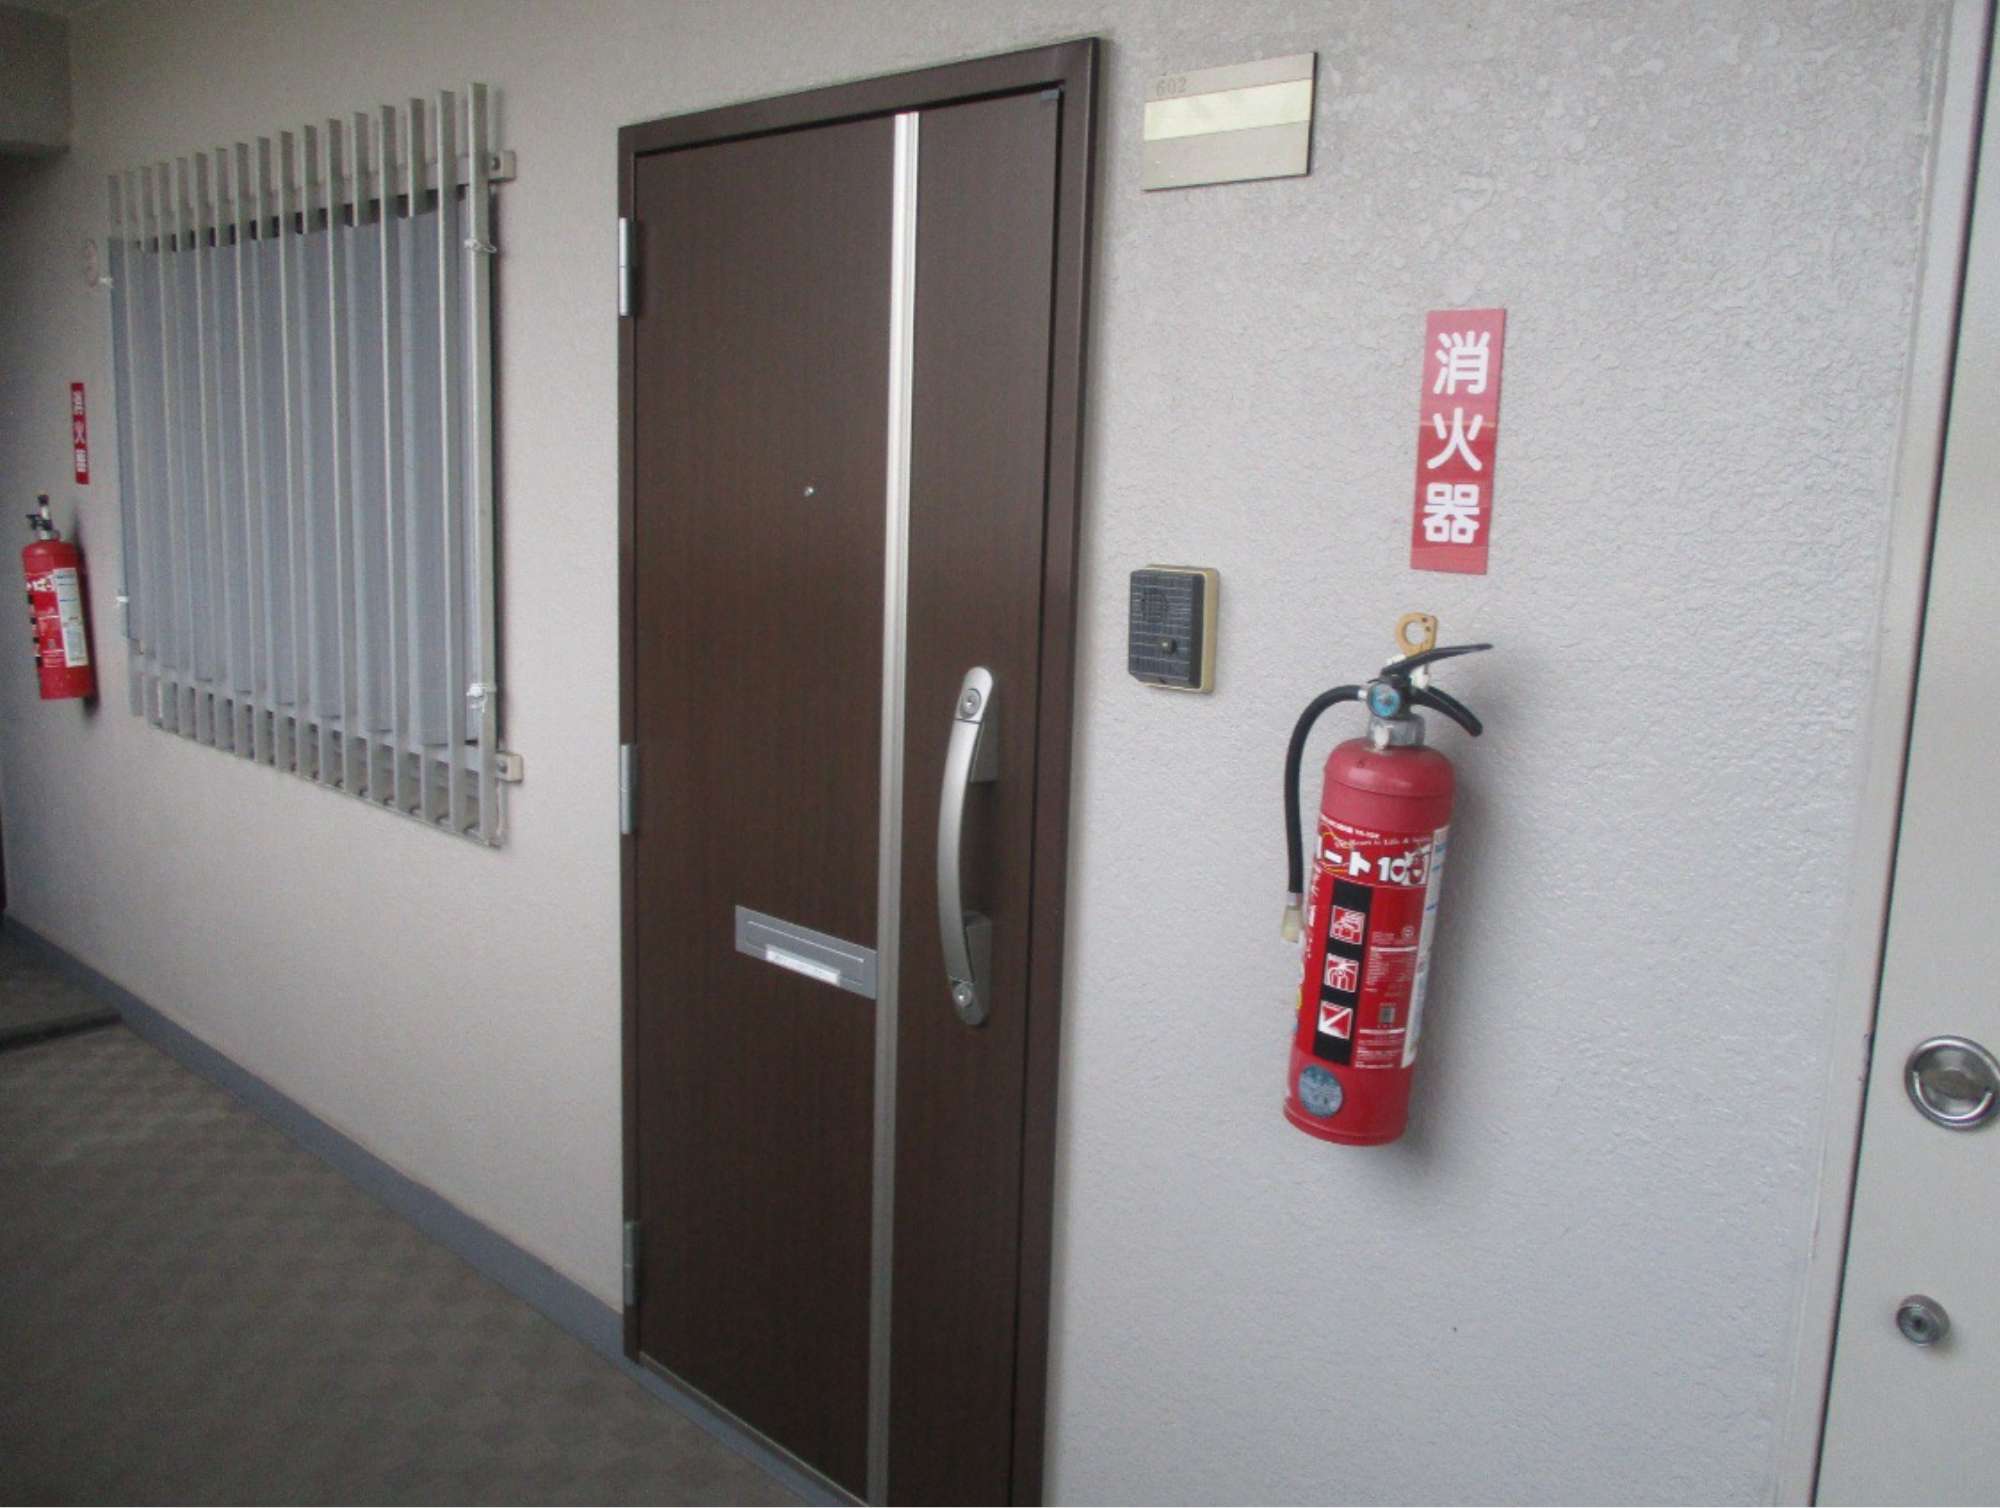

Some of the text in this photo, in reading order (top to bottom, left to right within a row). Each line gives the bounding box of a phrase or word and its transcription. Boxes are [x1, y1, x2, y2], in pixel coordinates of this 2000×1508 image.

[1156, 76, 1187, 97] 602
[1423, 330, 1491, 544] 消火器
